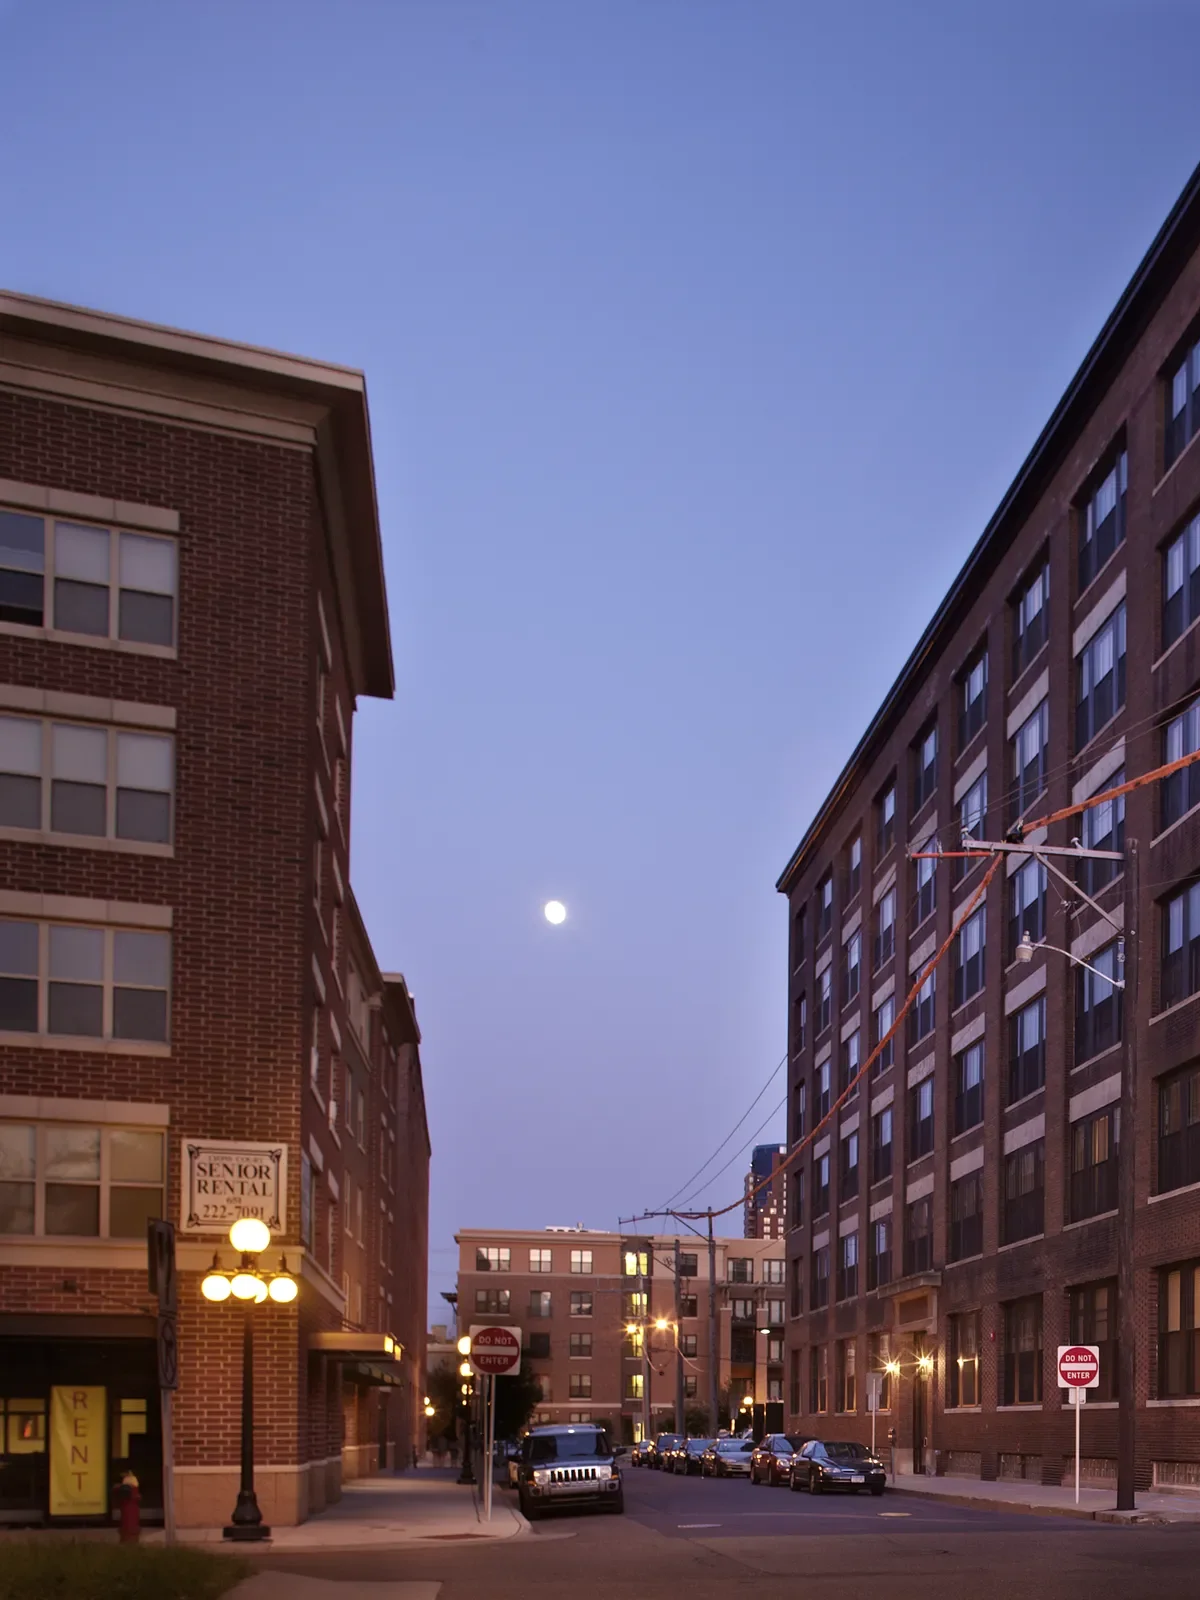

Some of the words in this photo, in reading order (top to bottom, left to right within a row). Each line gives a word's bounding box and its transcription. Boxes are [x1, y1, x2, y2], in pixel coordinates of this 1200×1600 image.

[197, 1163, 271, 1180] SENIOR
[197, 1179, 273, 1197] RENTAL
[203, 1204, 265, 1220] 222-7091
[479, 1336, 491, 1344] DO
[495, 1337, 512, 1345] NOT
[480, 1357, 509, 1365] ENTER
[71, 1390, 89, 1493] RENT
